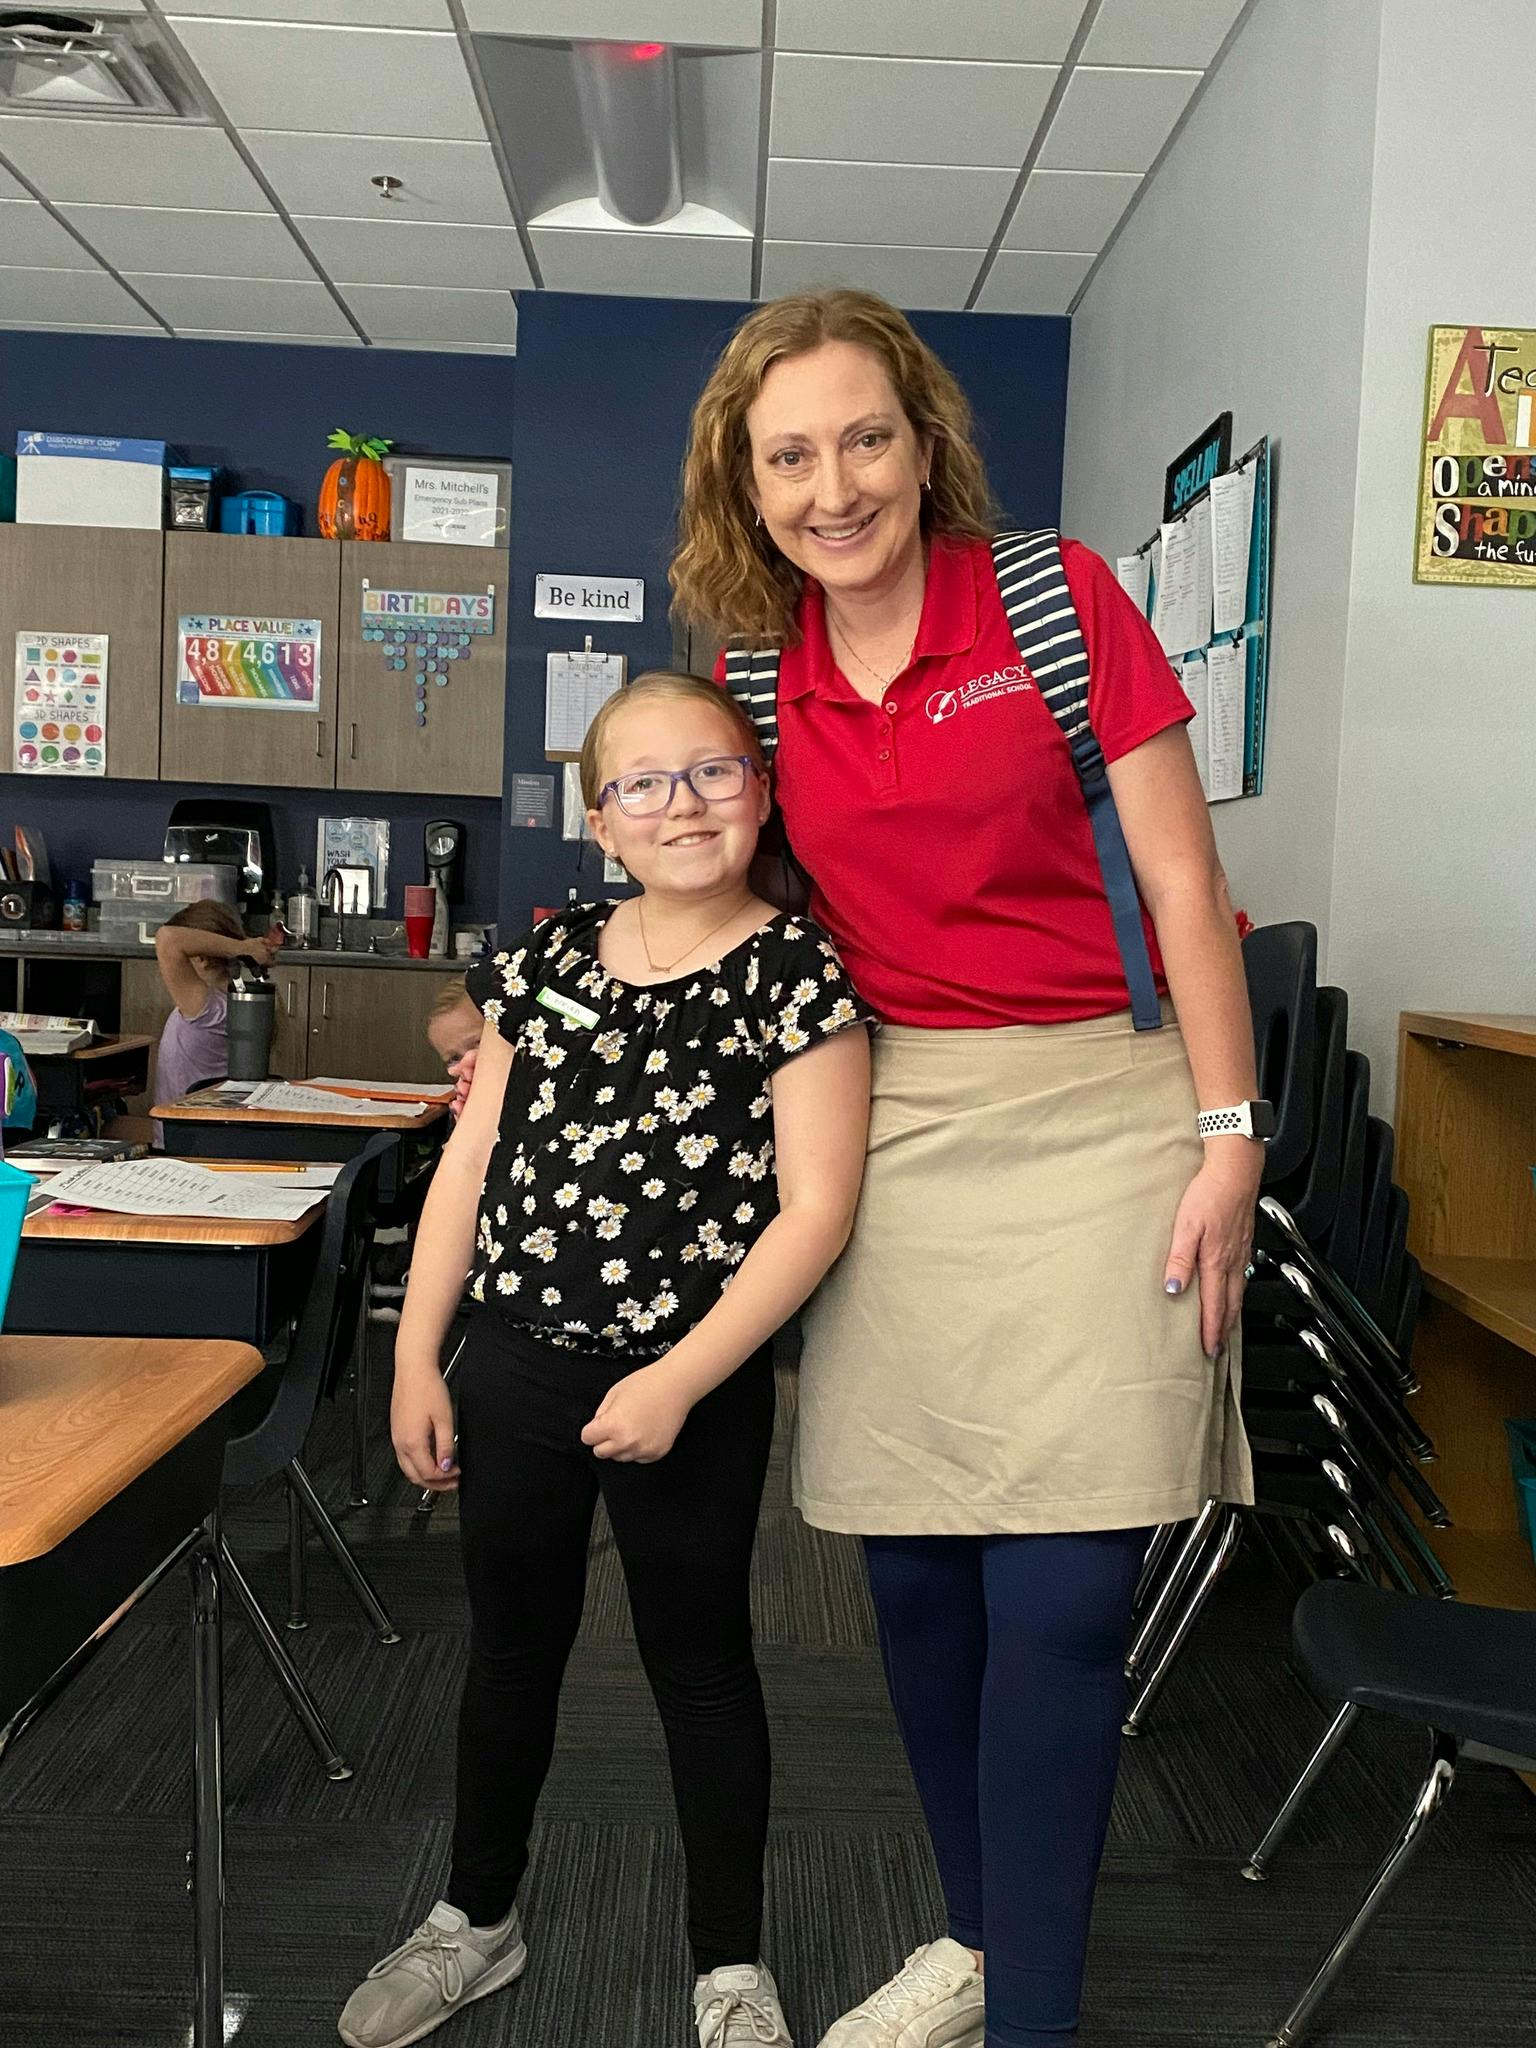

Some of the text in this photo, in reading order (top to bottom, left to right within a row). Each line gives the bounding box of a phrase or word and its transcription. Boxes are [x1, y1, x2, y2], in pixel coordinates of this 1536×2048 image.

[1427, 326, 1507, 445] A
[46, 434, 97, 446] DISCOVERY
[97, 439, 121, 448] COPY
[415, 479, 489, 495] Mrs. Mitchell's
[1477, 481, 1492, 496] a
[414, 494, 452, 504] Emergency
[453, 496, 467, 505] Sub
[1474, 540, 1509, 561] the
[365, 592, 489, 617] BIRTHDAYS
[548, 586, 630, 609] Be kind
[209, 618, 294, 635] PLACE VALUE
[51, 637, 91, 648] SHAPES
[958, 664, 1028, 699] LEGACY
[962, 683, 1035, 710] TRADITIONAL SCHOOL
[34, 710, 89, 722] 3D SHAPES
[327, 849, 350, 858] WASH
[7, 901, 15, 912] 1
